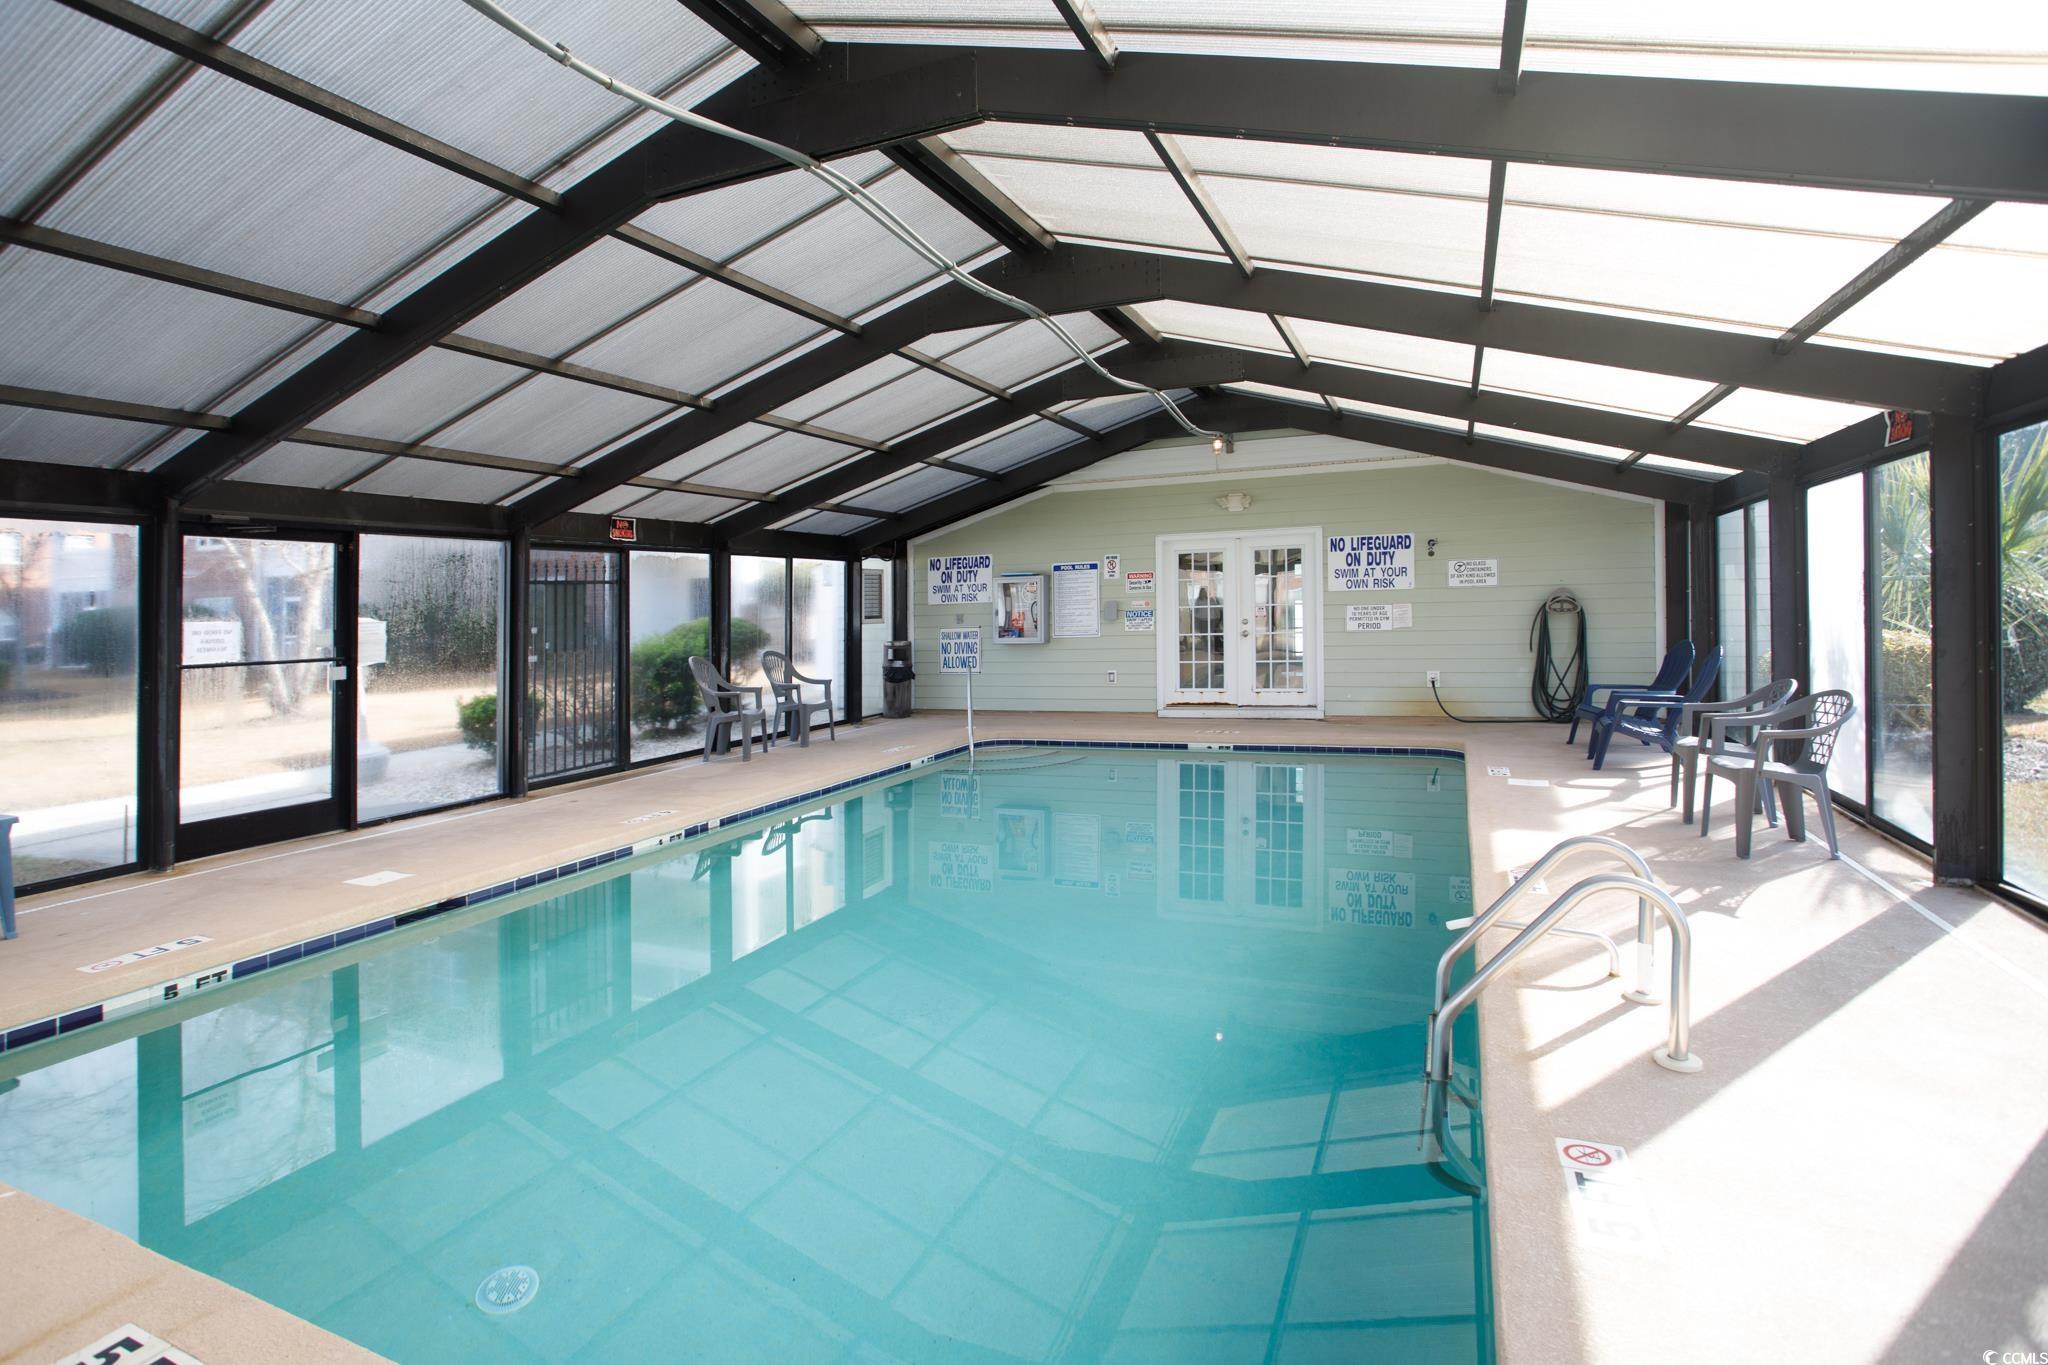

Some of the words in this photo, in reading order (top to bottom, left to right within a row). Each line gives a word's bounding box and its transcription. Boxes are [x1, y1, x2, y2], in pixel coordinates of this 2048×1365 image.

[1330, 538, 1345, 552] NO
[1351, 535, 1412, 550] LIFEGUARD
[930, 559, 941, 571] NO
[945, 556, 990, 570] LIFEGUARD
[1346, 552, 1361, 566] ON
[1367, 551, 1395, 566] DUTY
[941, 572, 953, 584] ON
[957, 570, 978, 583] DUTY
[1335, 568, 1359, 578] SWIM
[1363, 568, 1376, 578] AT
[1381, 567, 1408, 577] YOUR
[933, 585, 951, 593] SWIM
[954, 584, 965, 592] AT
[968, 583, 987, 592] YOUR
[1346, 579, 1368, 589] OWN
[1373, 578, 1395, 588] RISK
[941, 594, 958, 603] OWN
[961, 593, 978, 602] RISK
[941, 632, 961, 640] SHALLOW
[963, 631, 978, 640] WATER
[942, 642, 951, 655] NO
[954, 642, 978, 655] DIVING
[942, 656, 977, 669] ALLOWED
[164, 984, 178, 1000] 5
[196, 970, 228, 990] FT
